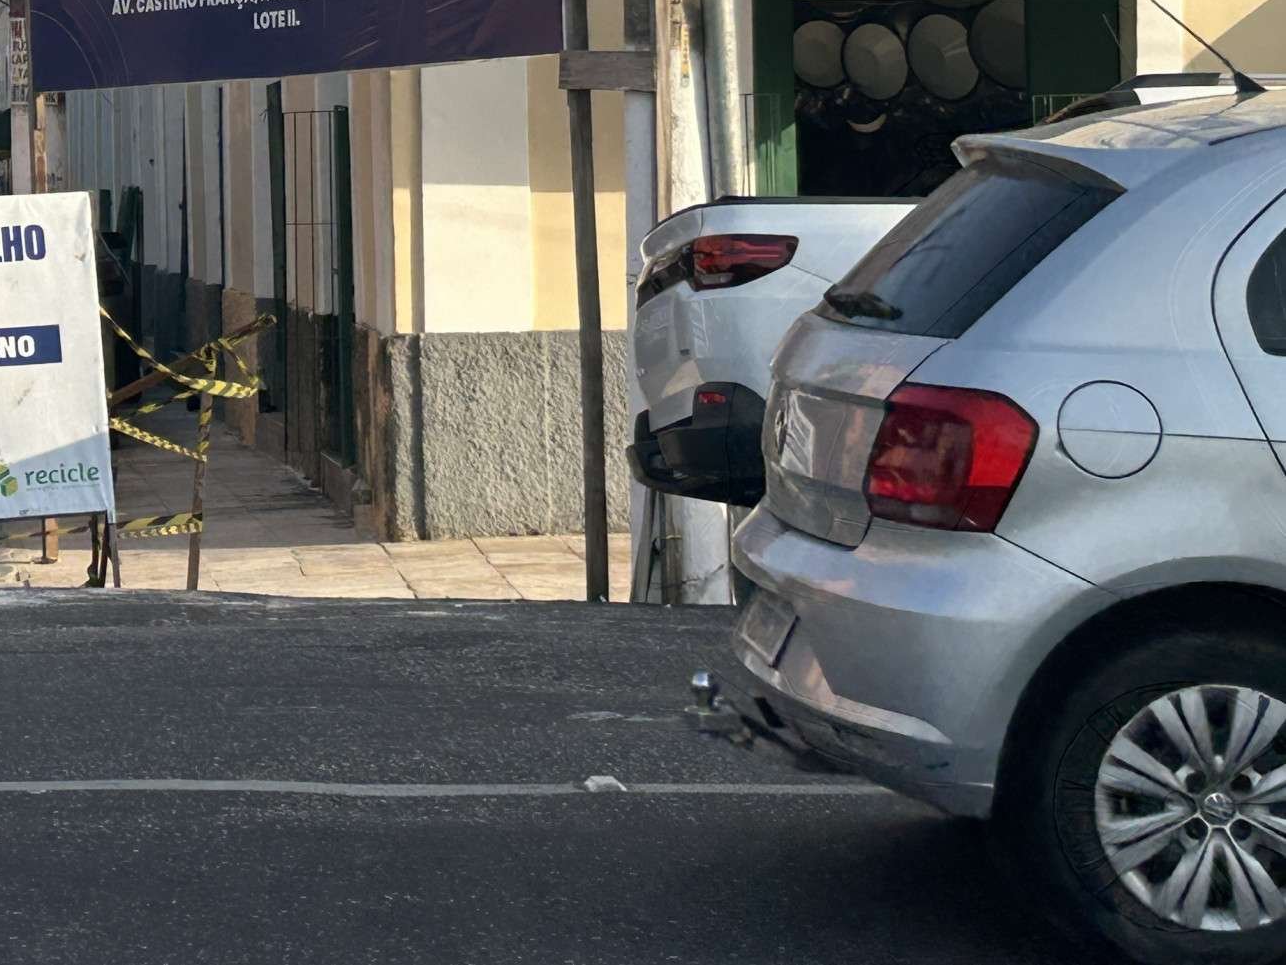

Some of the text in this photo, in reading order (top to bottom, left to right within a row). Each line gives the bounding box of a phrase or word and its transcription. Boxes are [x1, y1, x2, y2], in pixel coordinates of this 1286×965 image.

[253, 9, 301, 30] LOTE II.
[24, 462, 101, 486] recicle
